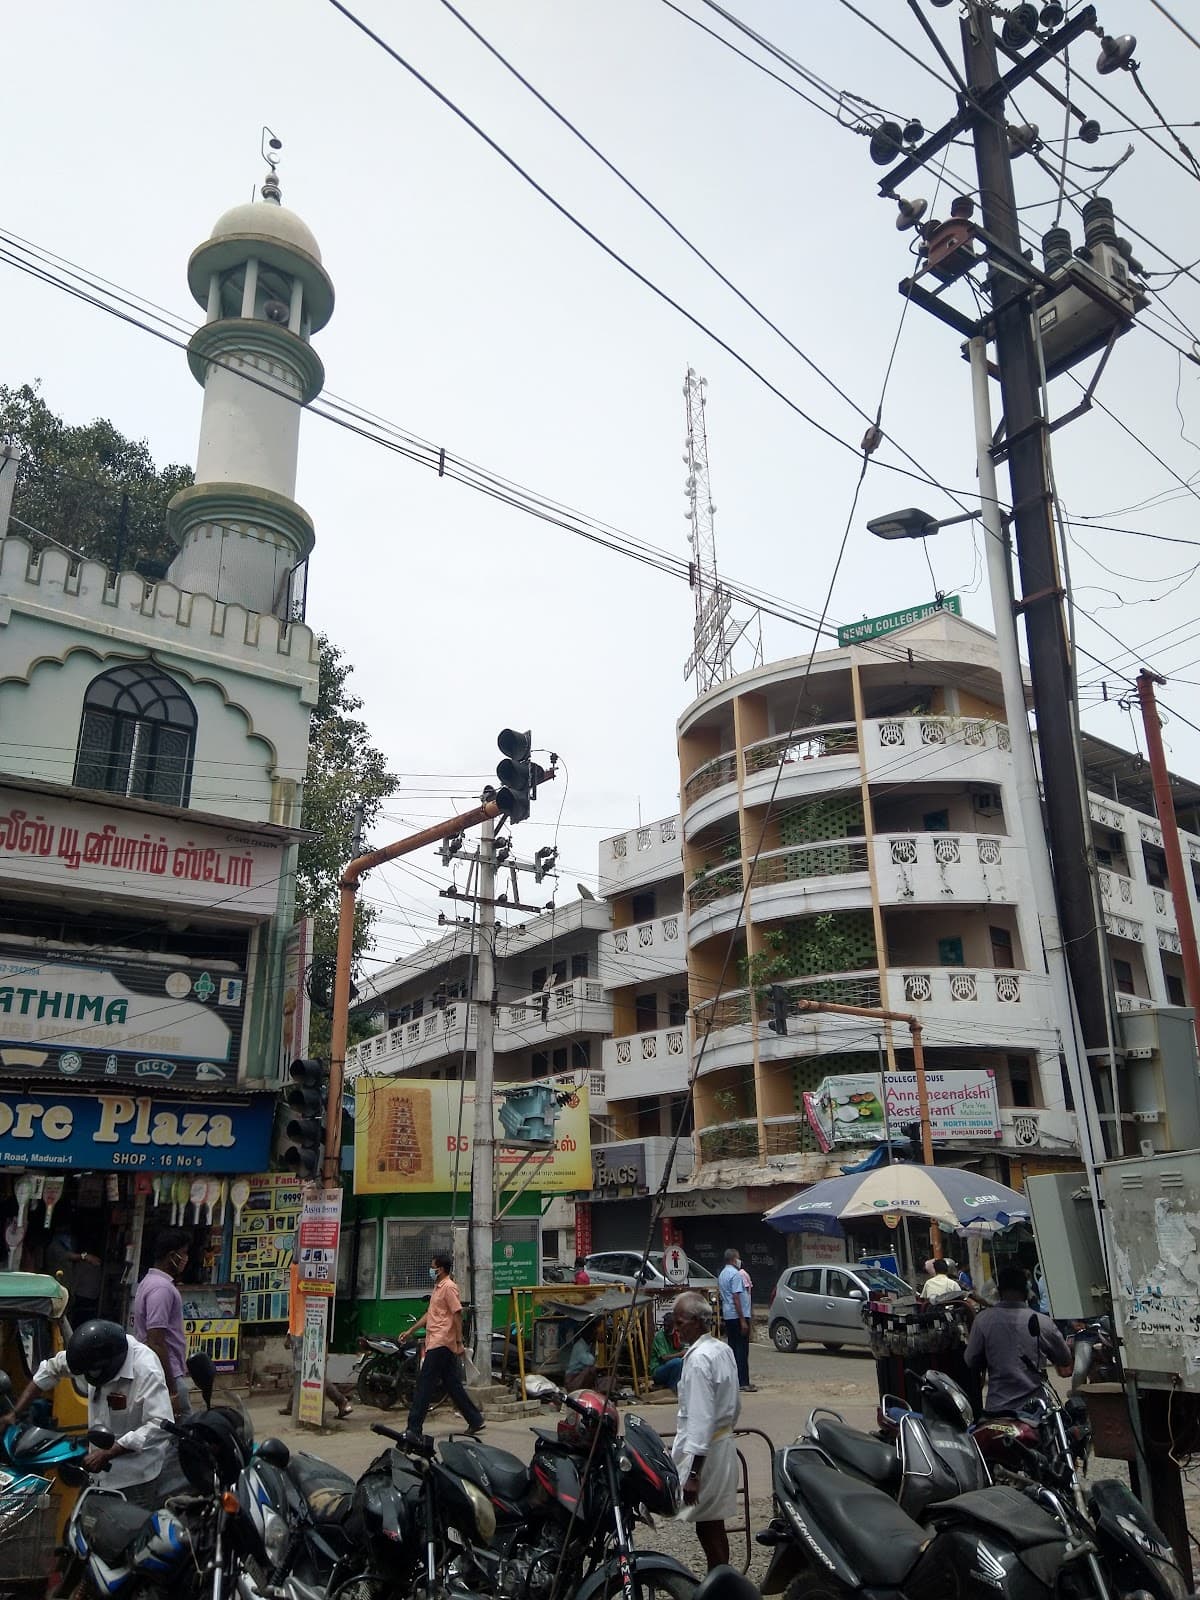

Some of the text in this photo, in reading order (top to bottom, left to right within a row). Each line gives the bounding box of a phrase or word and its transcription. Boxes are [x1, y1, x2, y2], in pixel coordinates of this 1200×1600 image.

[843, 623, 873, 640] NEWW
[876, 611, 919, 632] COLLEGE
[171, 840, 255, 888] ஸ்டோர்
[141, 1061, 170, 1074] NCC
[887, 1103, 956, 1117] Restarant
[92, 1096, 236, 1148] Plaza
[969, 1119, 993, 1127] INDIAN
[446, 1136, 469, 1152] BG
[4, 1152, 28, 1163] Road,
[31, 1153, 73, 1164] Madurai-1
[112, 1152, 147, 1165] SHOP
[160, 1155, 173, 1167] 16
[176, 1156, 203, 1167] No's
[976, 1195, 1001, 1204] GEM
